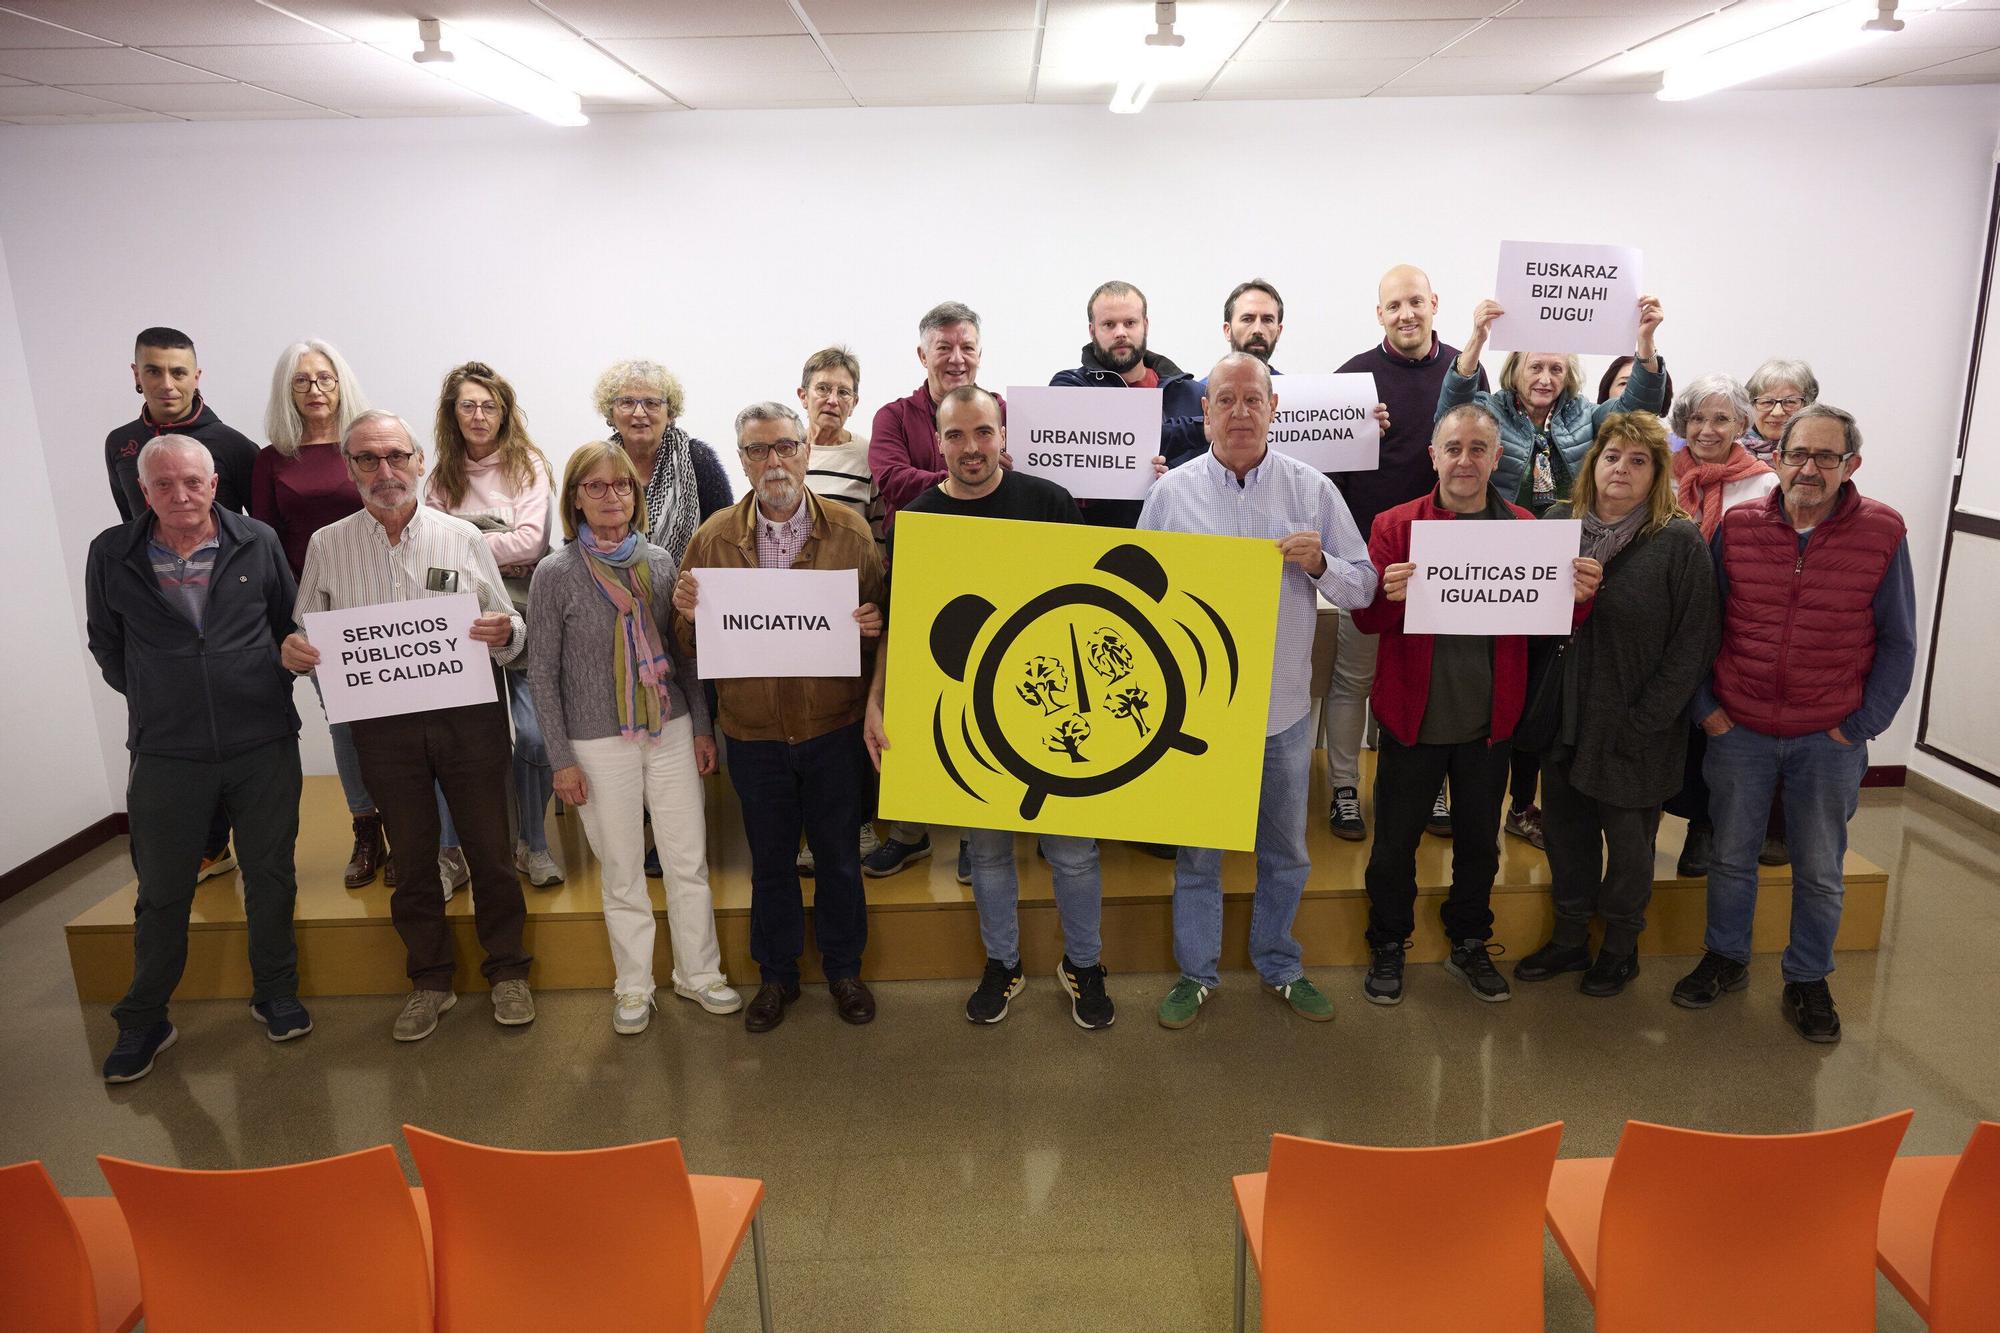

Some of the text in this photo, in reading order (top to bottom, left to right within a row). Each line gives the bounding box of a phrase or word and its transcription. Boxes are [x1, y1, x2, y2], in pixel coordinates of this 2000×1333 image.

[1525, 262, 1618, 279] EUSKARAZ
[1531, 284, 1608, 300] BIZI NAHI
[1539, 306, 1594, 321] DUGU!
[1270, 405, 1365, 423] RTICIPACIÓN
[1030, 429, 1136, 446] URBANISMO
[1266, 428, 1354, 443] CIUDADANA
[1027, 452, 1137, 469] SOSTENIBLE
[1426, 563, 1558, 581] POLÍTICAS DE
[1440, 588, 1539, 603] IGUALDAD
[342, 617, 449, 644] SERVICIOS
[722, 614, 831, 631] INICIATIVA
[341, 637, 458, 666] PÚBLICOS Y
[345, 659, 464, 688] DE CALIDAD
